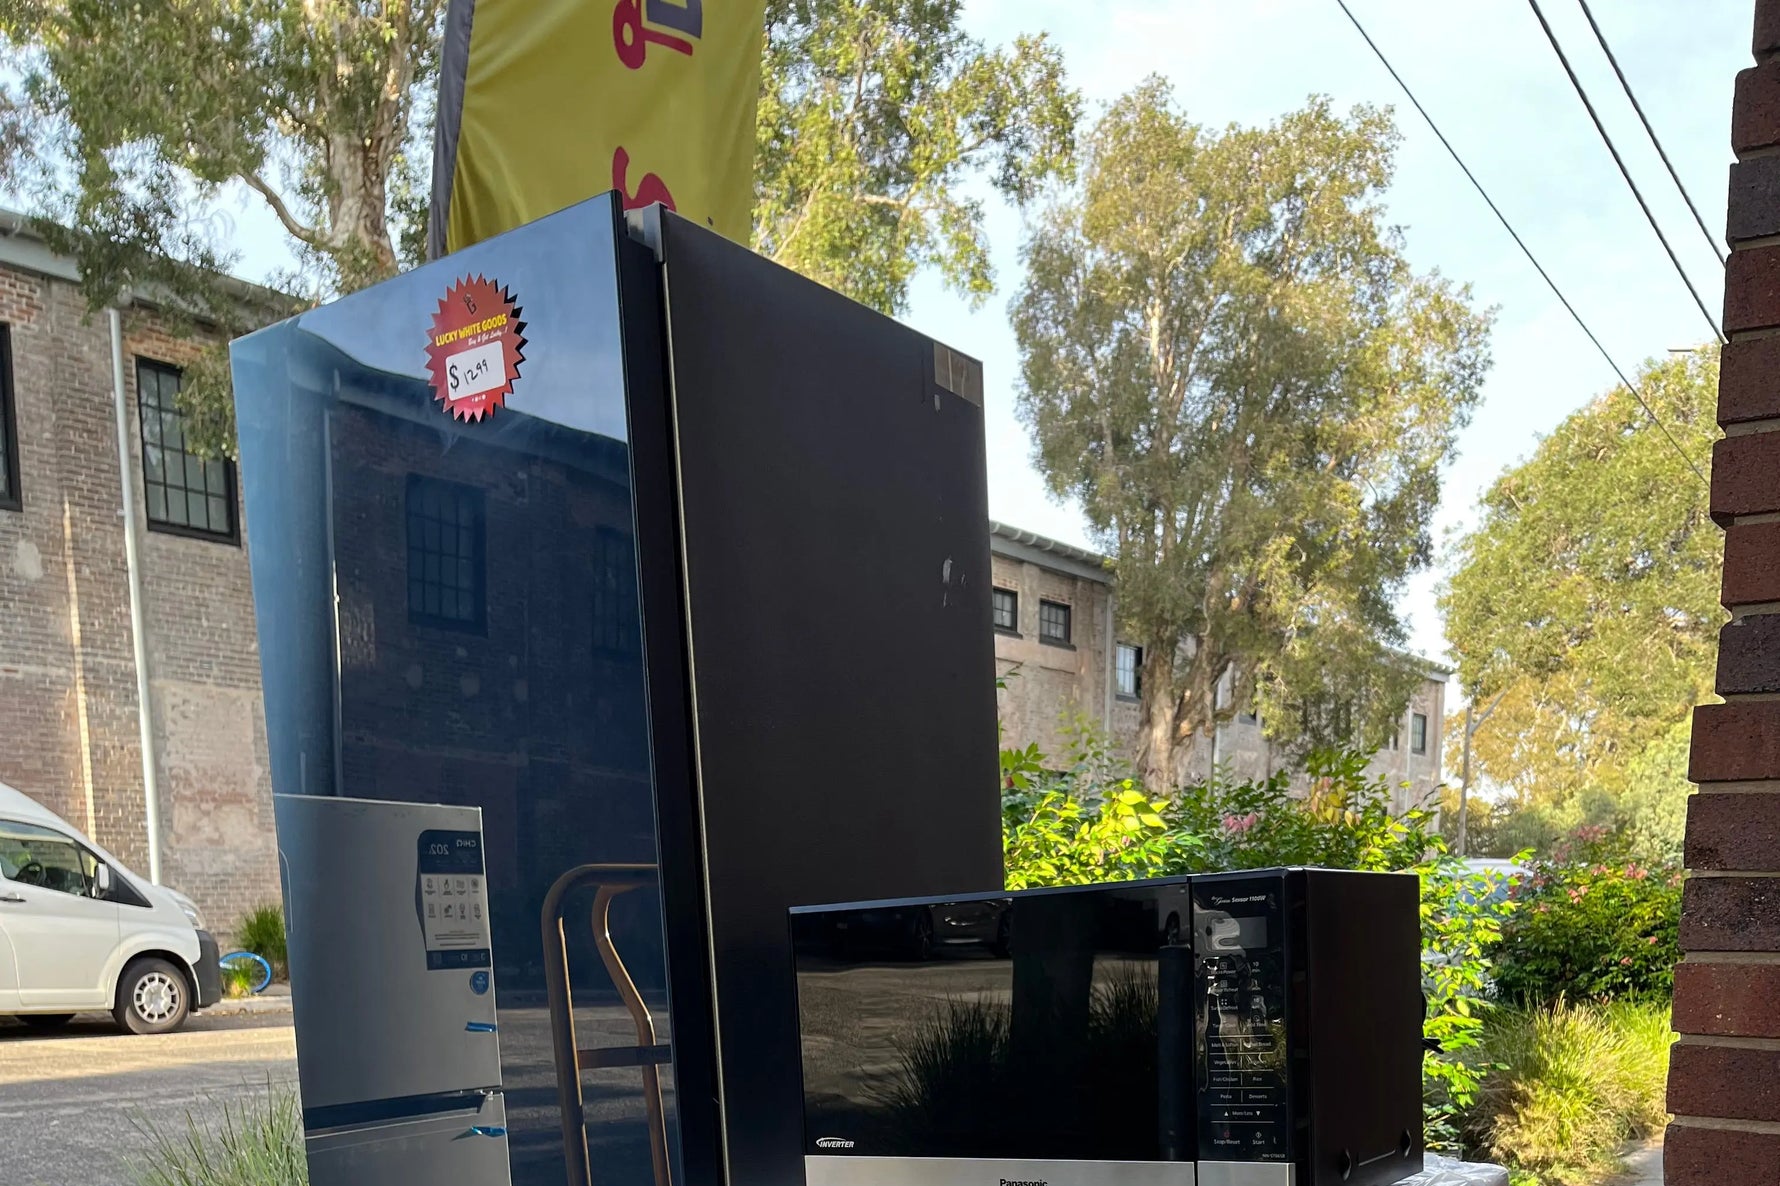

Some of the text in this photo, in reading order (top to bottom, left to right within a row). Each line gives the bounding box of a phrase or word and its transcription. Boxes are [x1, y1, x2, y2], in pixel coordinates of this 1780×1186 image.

[435, 313, 508, 347] LUCKY WHITE GOODS
[464, 359, 489, 385] 1299
[818, 1139, 855, 1149] INVERTER
